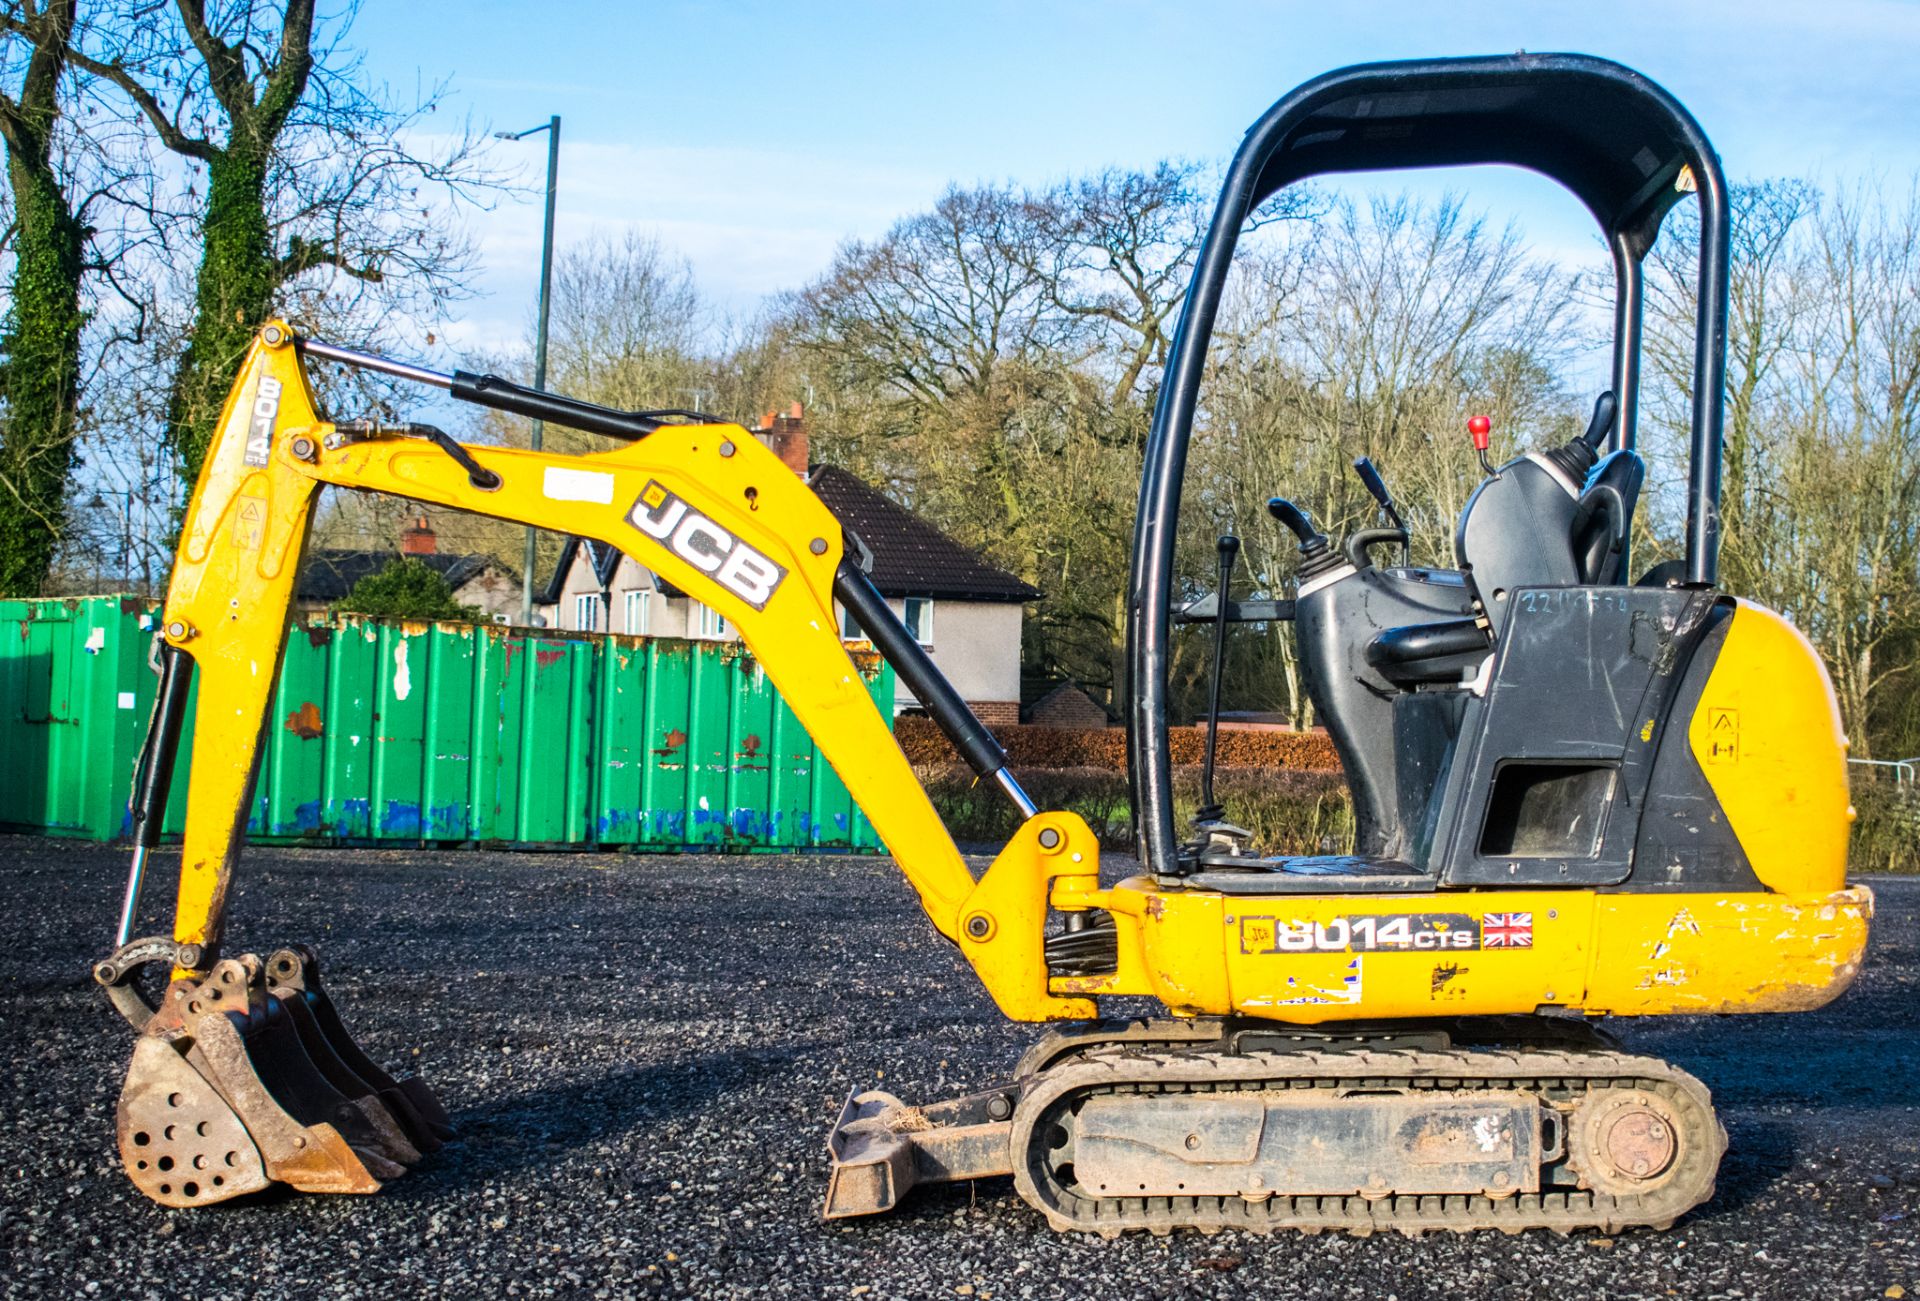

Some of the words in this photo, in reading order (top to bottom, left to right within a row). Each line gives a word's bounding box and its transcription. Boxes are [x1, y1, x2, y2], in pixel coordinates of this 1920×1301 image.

[247, 376, 281, 457] 8014
[632, 500, 779, 603] JCB
[1278, 917, 1414, 950] 8014
[1415, 931, 1473, 948] CTS
